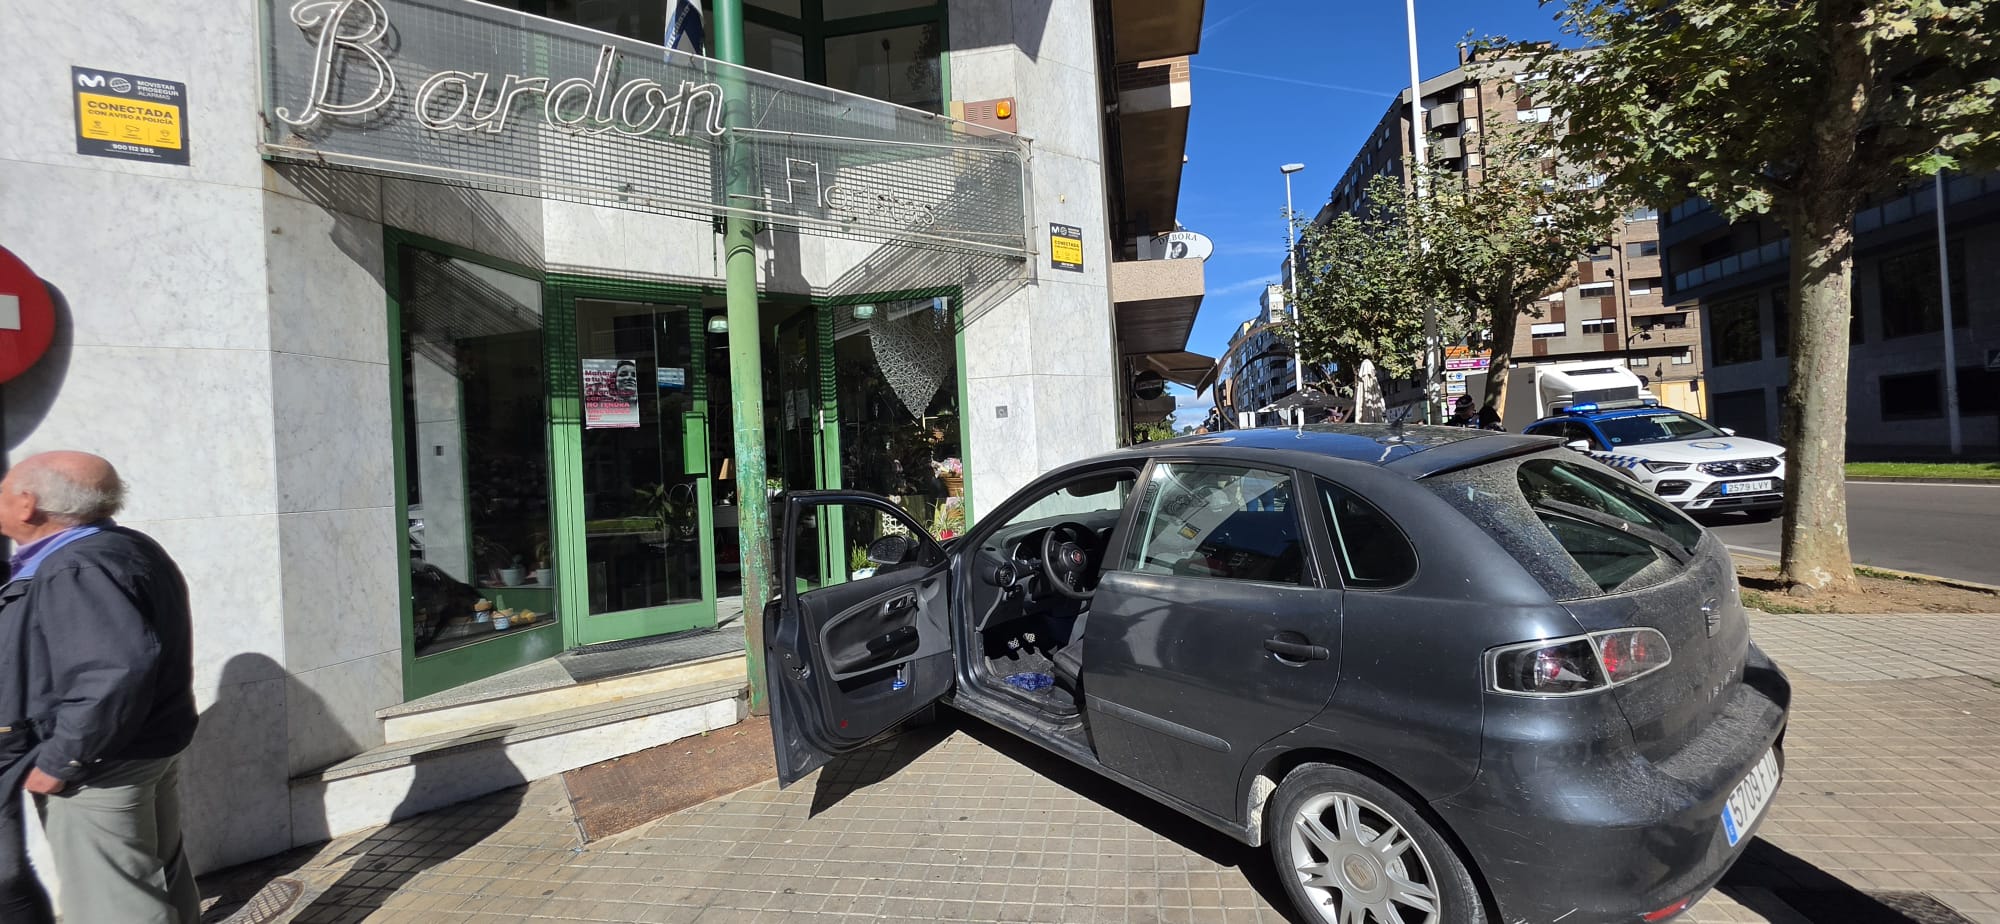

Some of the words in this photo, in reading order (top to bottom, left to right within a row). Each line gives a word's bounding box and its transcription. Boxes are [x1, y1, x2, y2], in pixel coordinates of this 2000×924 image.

[275, 0, 727, 137] Bardon
[137, 80, 175, 90] MOVISTAR
[137, 86, 179, 96] PROSEGUR
[138, 91, 171, 100] ALARMAS
[87, 109, 107, 117] CON
[108, 111, 134, 120] AVISO
[88, 101, 173, 118] CONECTADA
[112, 143, 127, 151] 900
[1752, 481, 1769, 490] LVY
[1728, 771, 1762, 828] 5709
